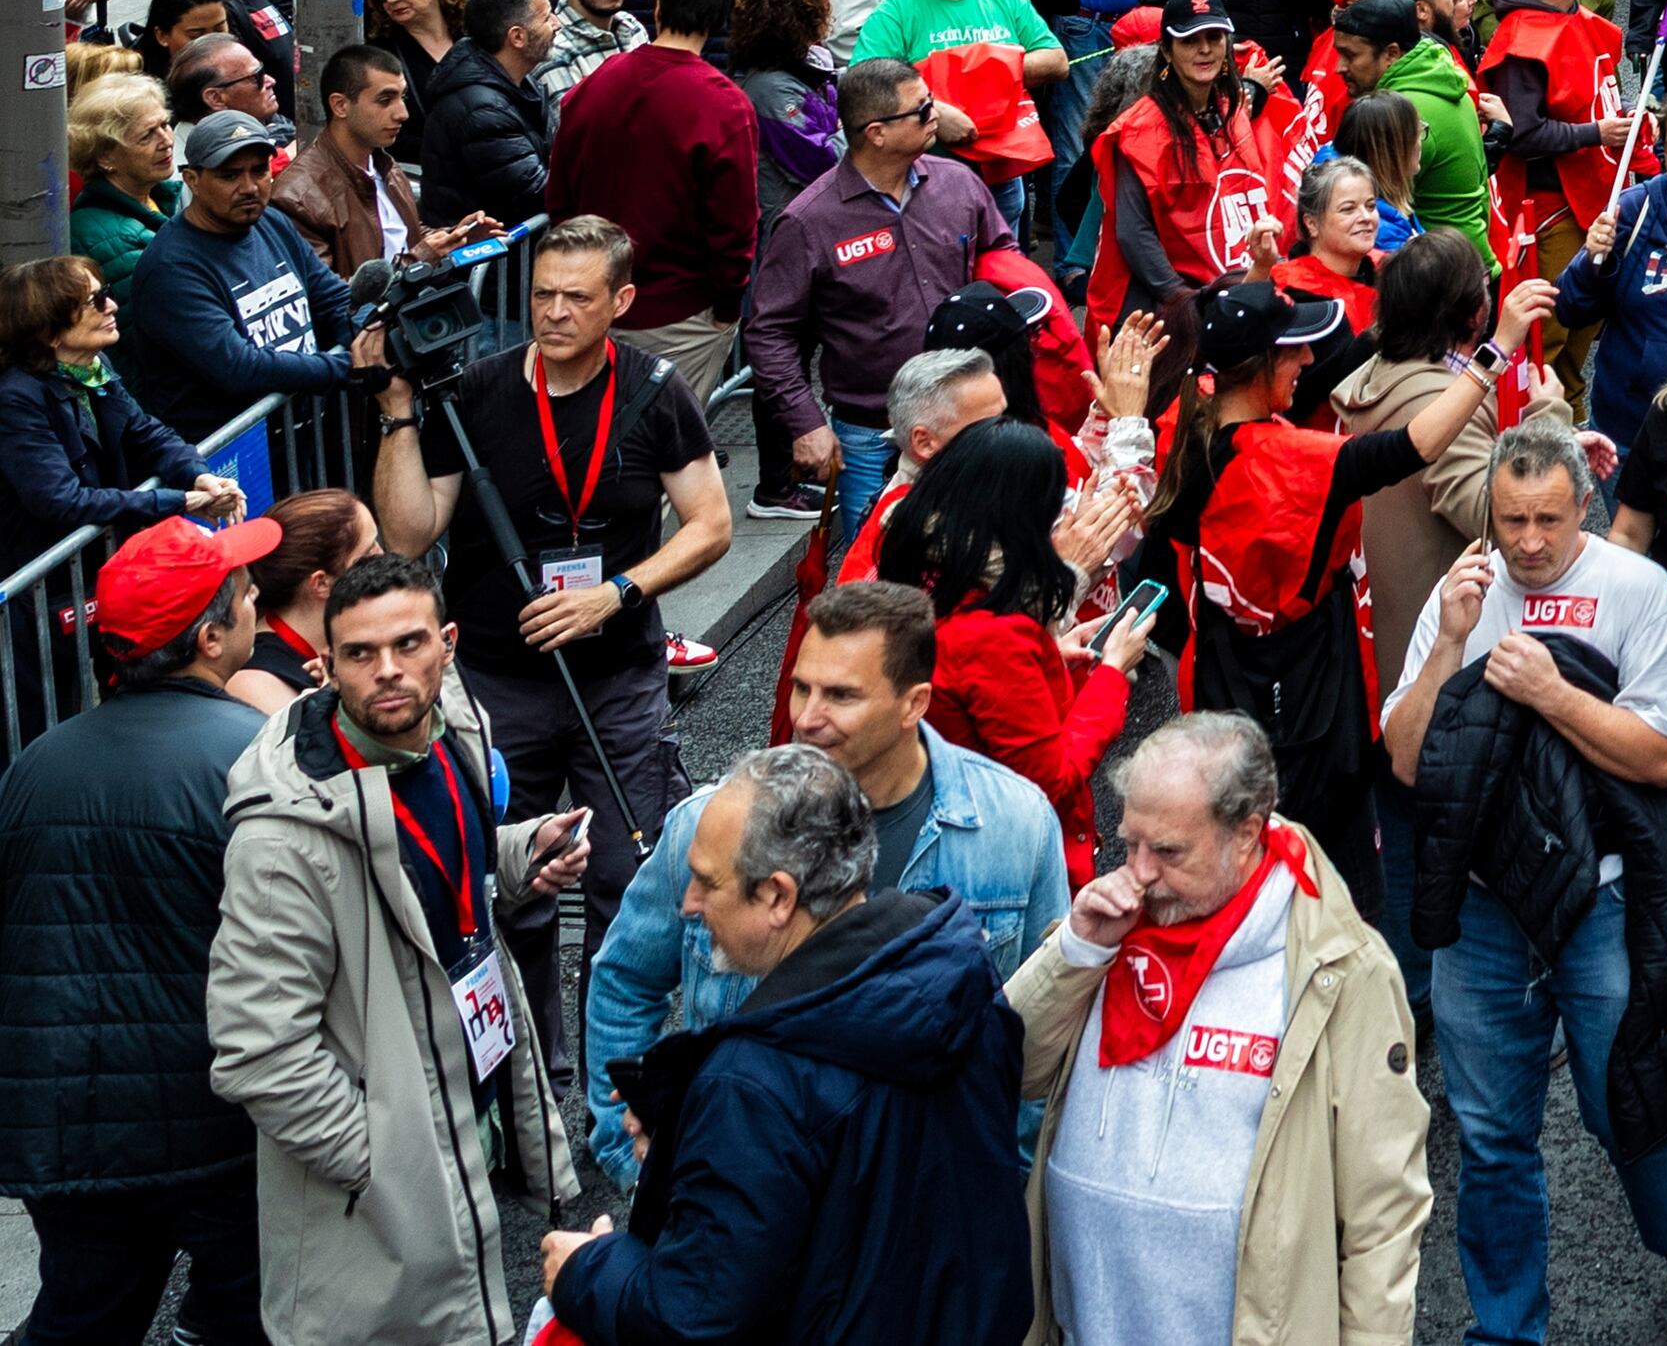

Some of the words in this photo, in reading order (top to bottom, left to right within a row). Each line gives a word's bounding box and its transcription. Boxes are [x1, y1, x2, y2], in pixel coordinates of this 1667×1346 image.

[462, 244, 493, 259] tve
[836, 236, 874, 262] UGT
[1525, 599, 1572, 623] UGT
[1186, 1031, 1250, 1064] UGT
